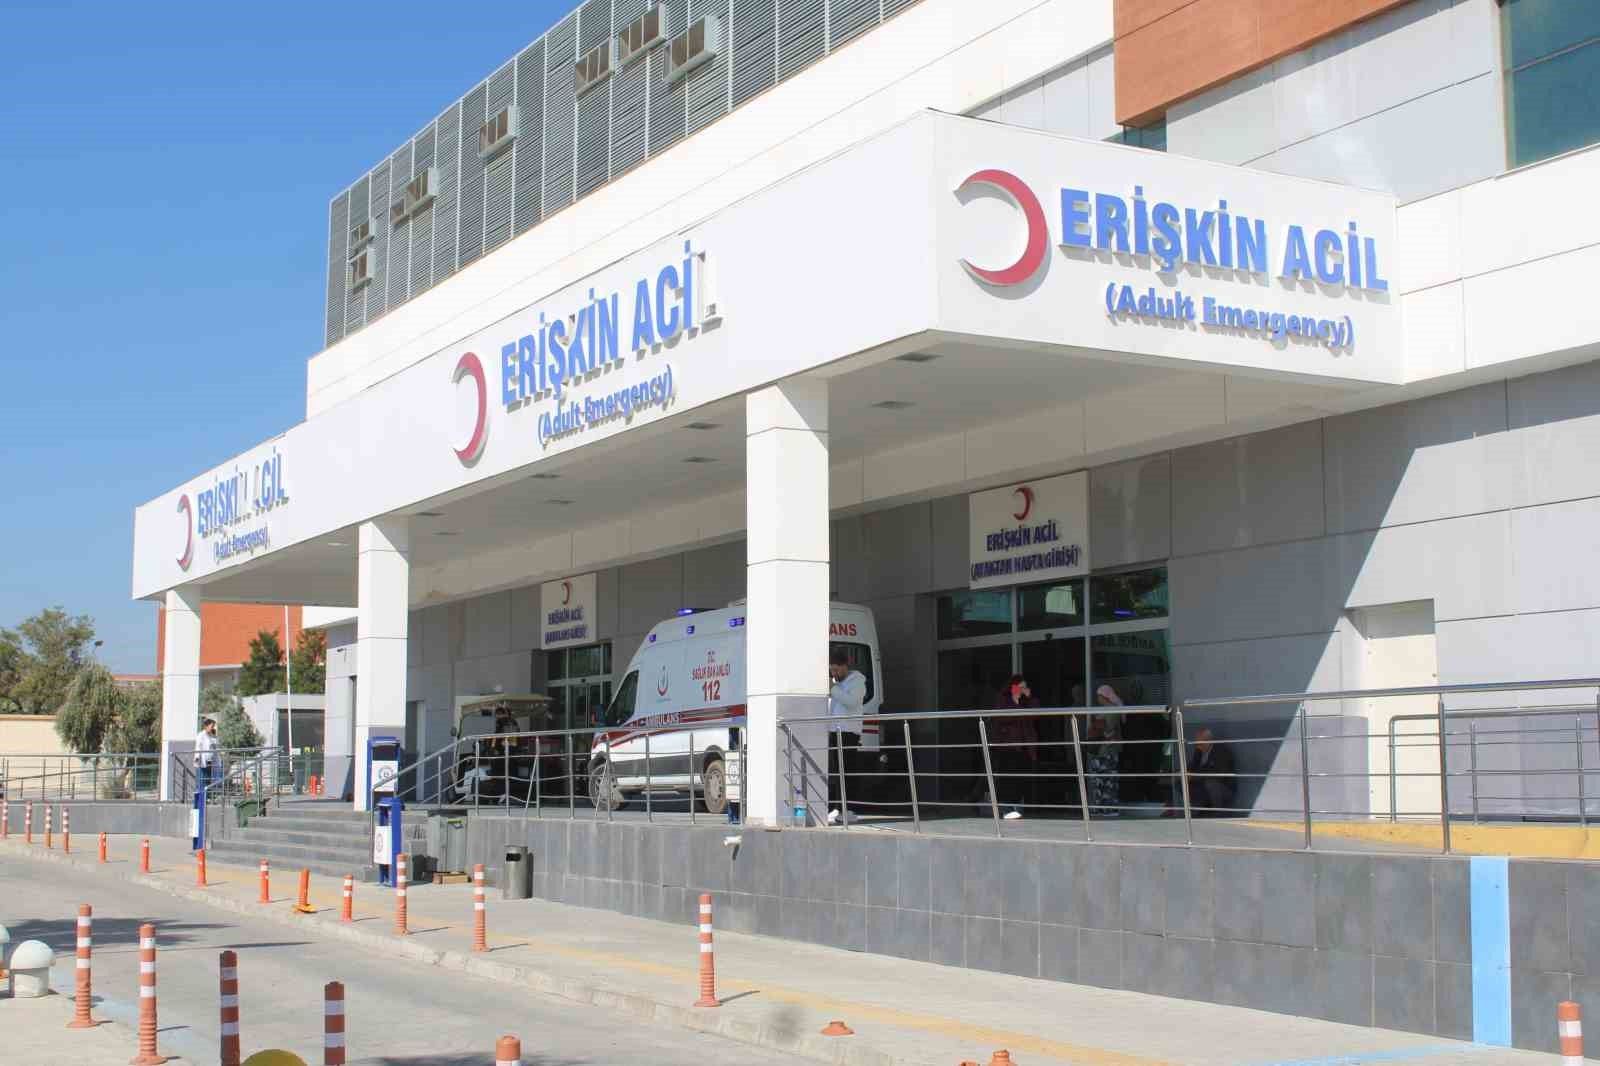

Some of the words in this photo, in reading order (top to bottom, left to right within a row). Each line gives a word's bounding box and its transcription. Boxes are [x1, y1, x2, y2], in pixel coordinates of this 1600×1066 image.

[1061, 185, 1267, 273] ERİŞKİN
[1281, 221, 1389, 291] ACİL
[1106, 282, 1195, 322] (Adult
[1203, 296, 1354, 347] Emergency)
[502, 287, 619, 405] ERİŞKİN
[583, 364, 674, 424] Emergency)
[829, 623, 857, 636] ANS
[702, 680, 721, 702] 112
